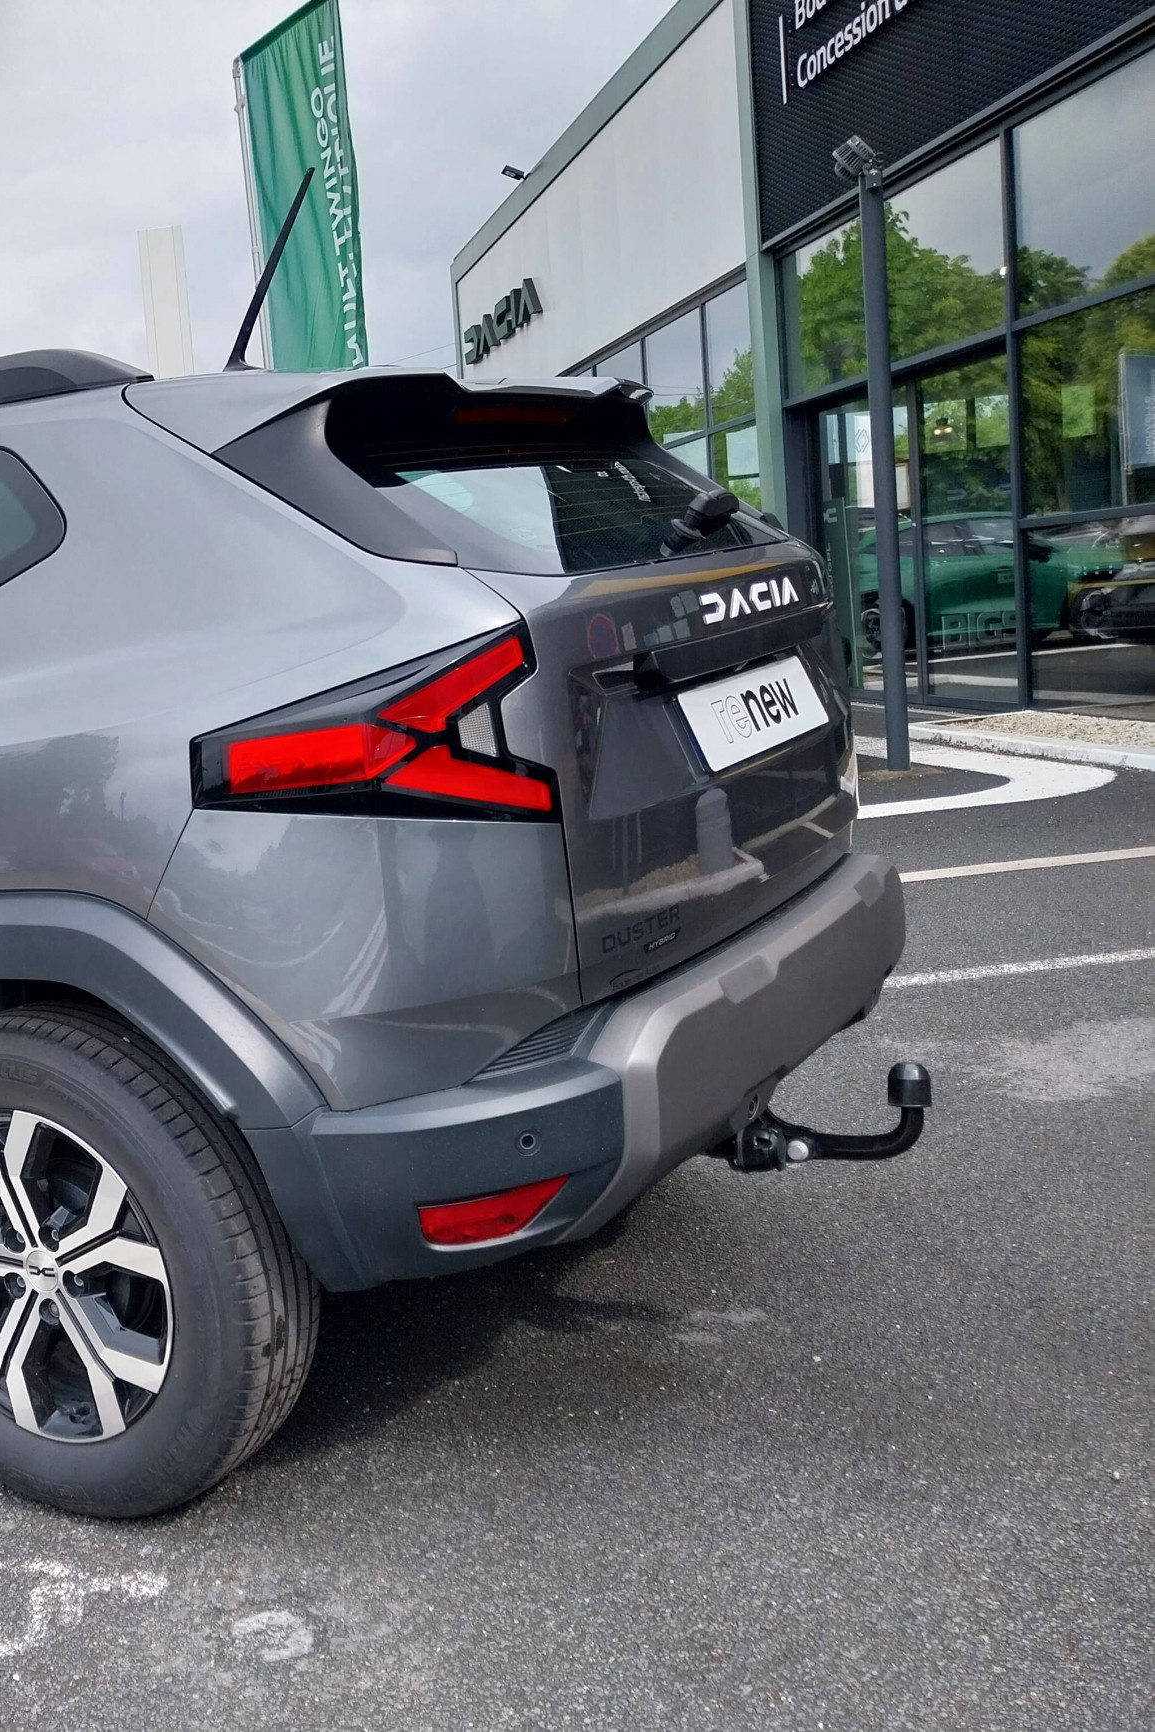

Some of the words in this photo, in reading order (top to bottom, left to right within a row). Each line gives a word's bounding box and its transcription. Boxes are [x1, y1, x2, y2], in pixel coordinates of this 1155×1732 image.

[797, 0, 891, 88] Concession
[311, 87, 347, 256] TWINGO
[464, 278, 543, 365] DACIA
[699, 577, 799, 625] DACIA
[711, 678, 799, 744] renew
[601, 904, 680, 954] DUSTER
